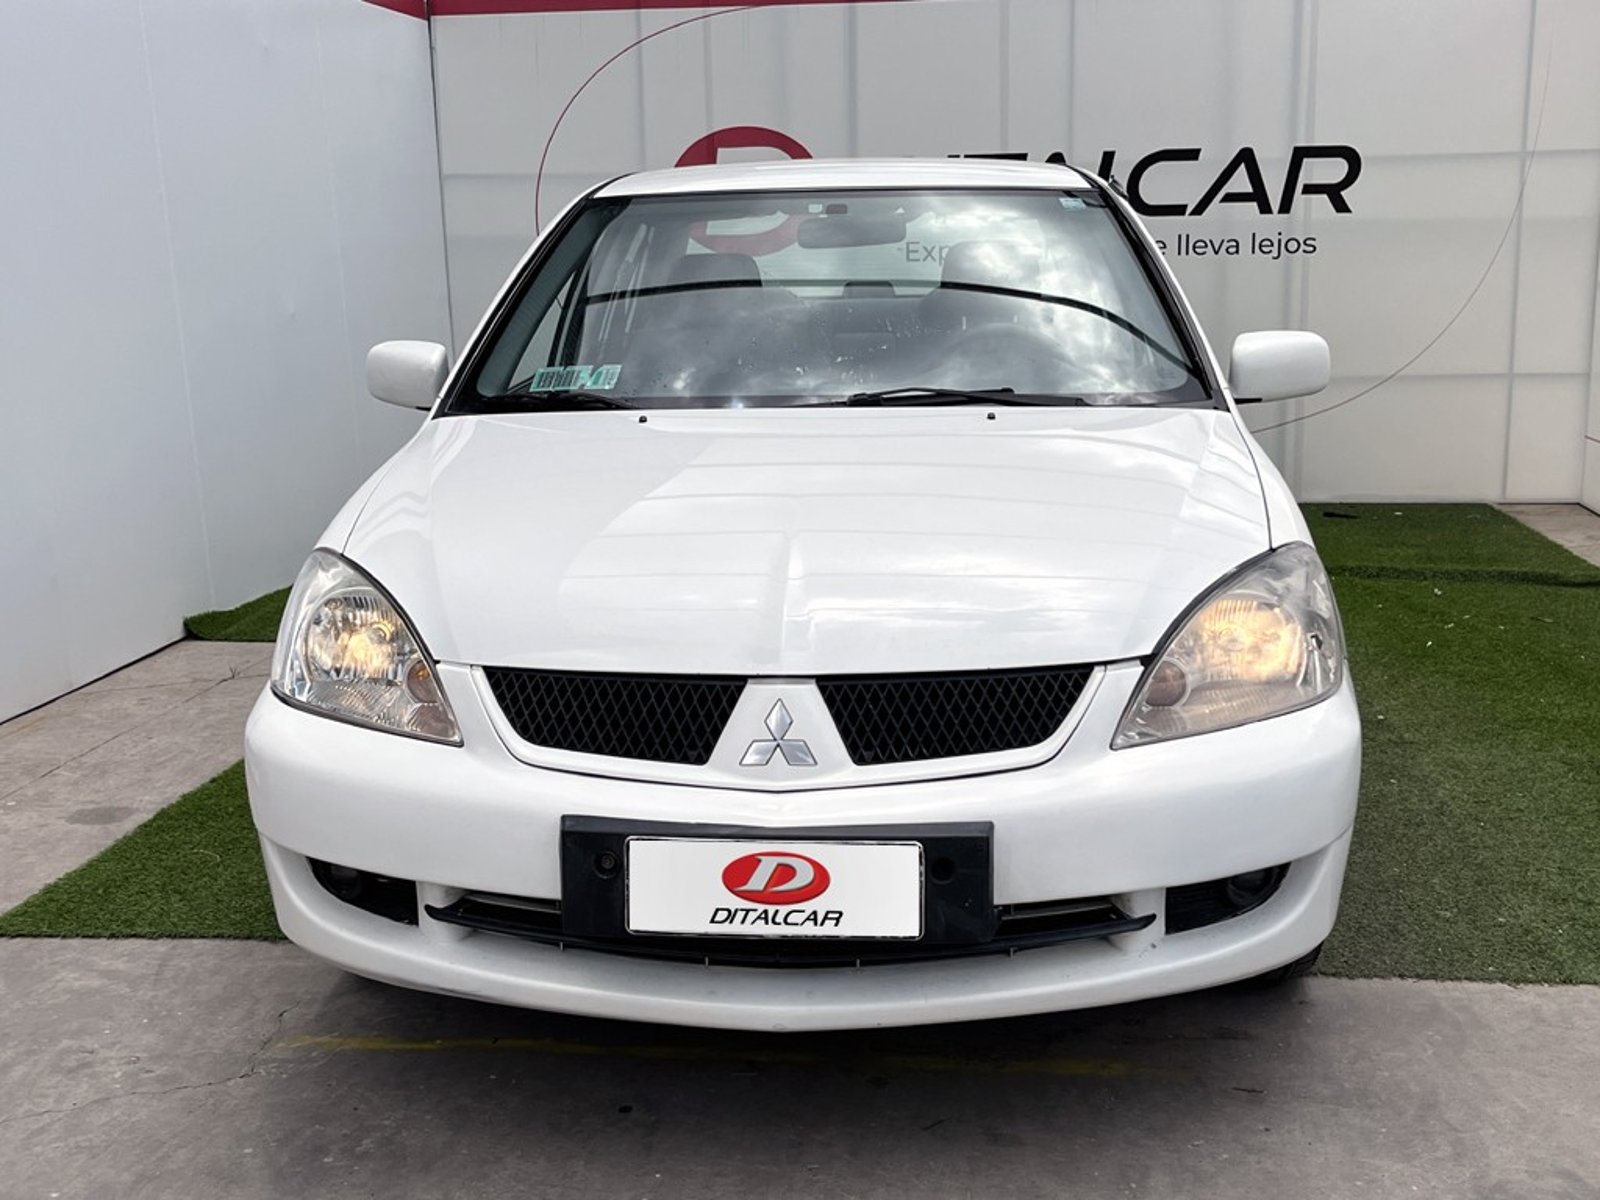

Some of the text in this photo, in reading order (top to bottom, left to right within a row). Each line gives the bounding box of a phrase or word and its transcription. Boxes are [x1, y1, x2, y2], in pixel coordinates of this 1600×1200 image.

[1176, 233, 1240, 256] lleva
[1251, 231, 1317, 260] lejos
[709, 907, 843, 927] DITALCAR
